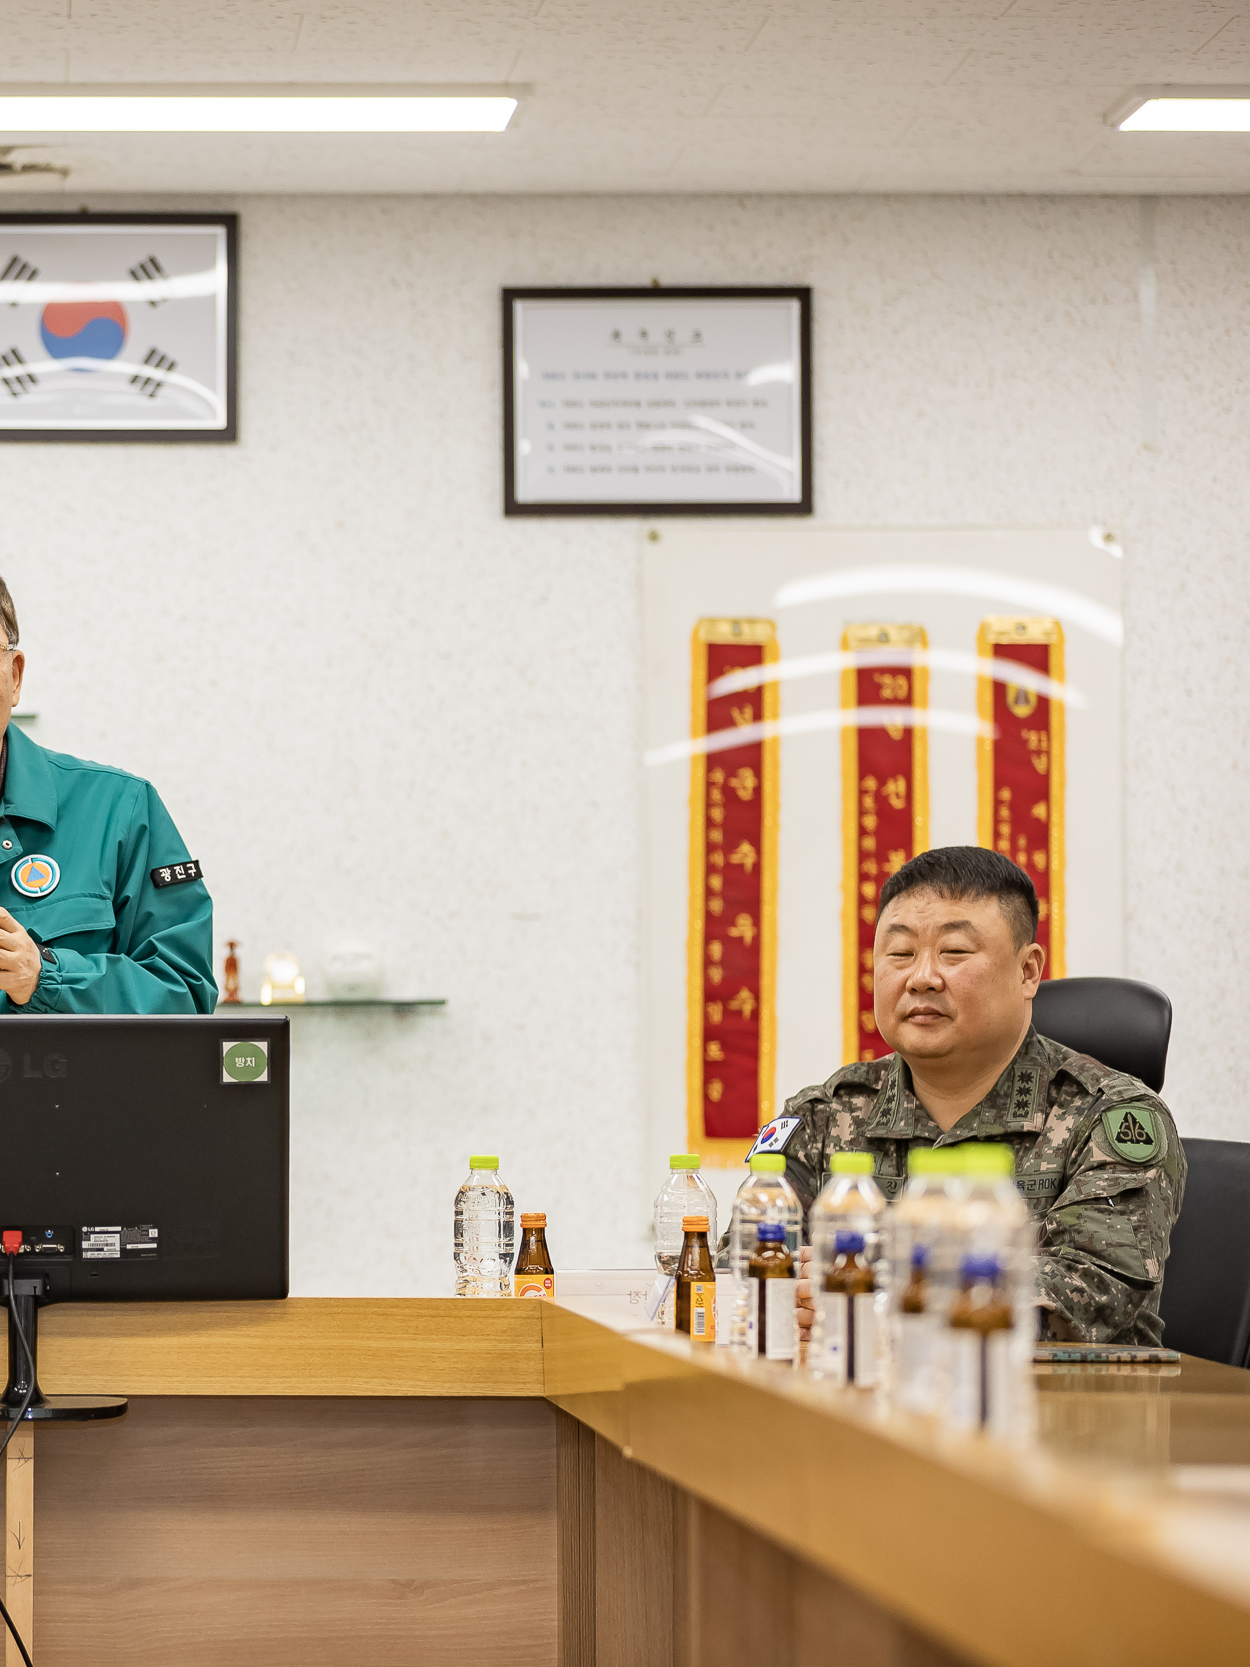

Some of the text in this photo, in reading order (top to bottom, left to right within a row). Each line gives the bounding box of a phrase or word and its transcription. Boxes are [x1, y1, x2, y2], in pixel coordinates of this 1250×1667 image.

[159, 863, 197, 881] 광진구
[23, 1052, 68, 1078] LG
[235, 1056, 256, 1068] 방치
